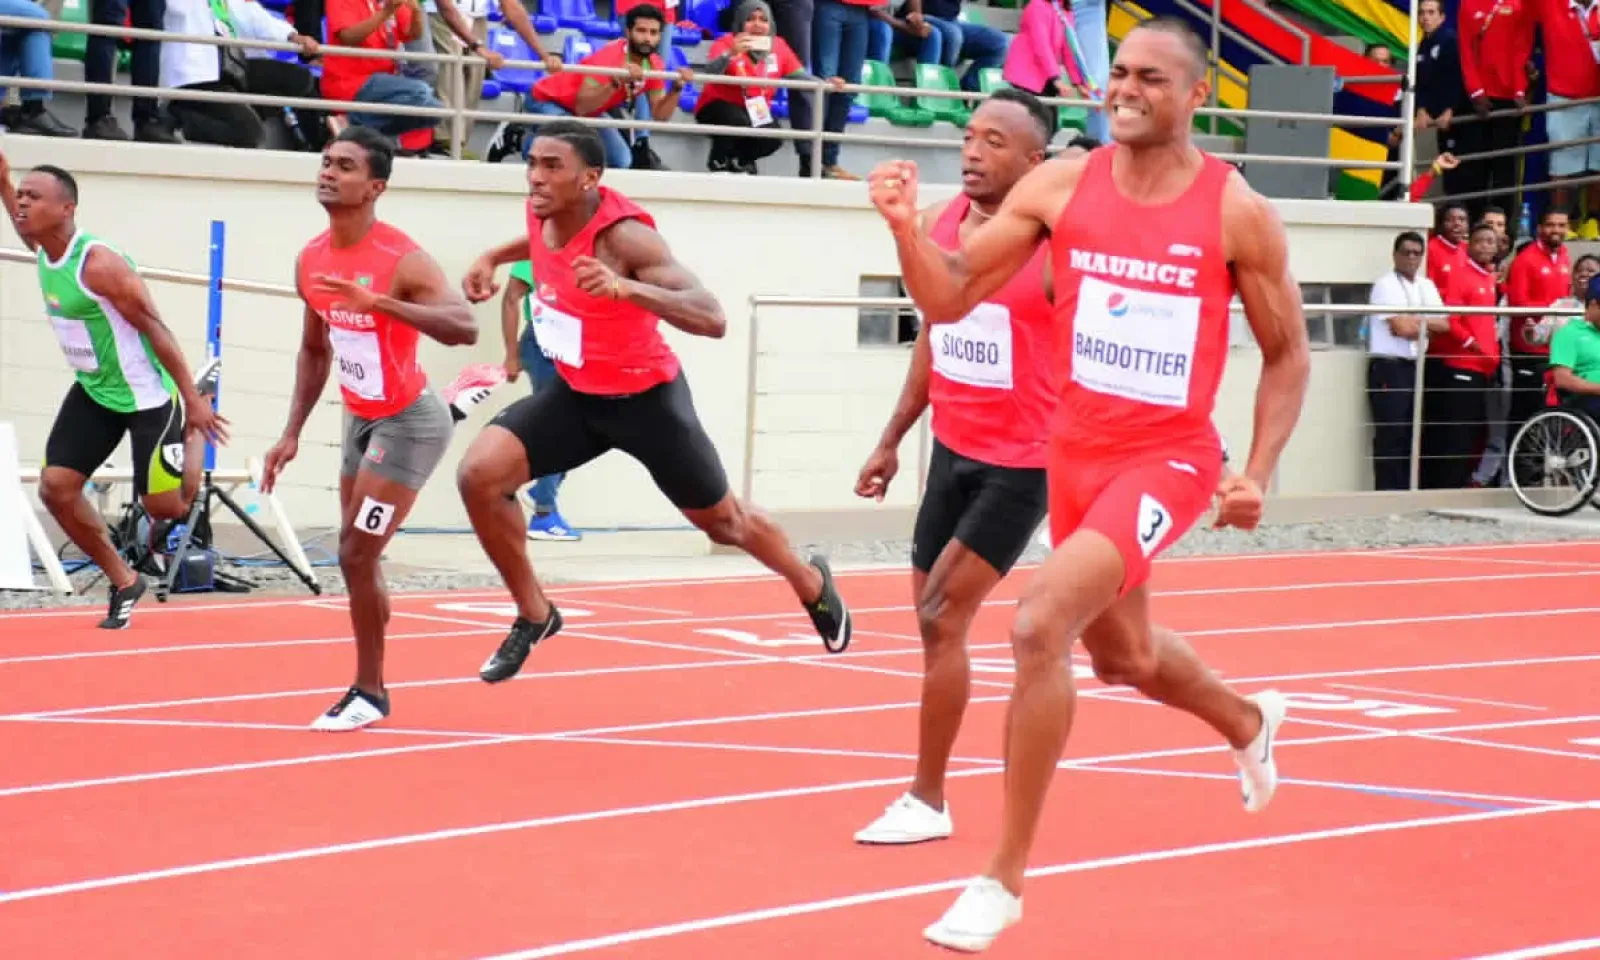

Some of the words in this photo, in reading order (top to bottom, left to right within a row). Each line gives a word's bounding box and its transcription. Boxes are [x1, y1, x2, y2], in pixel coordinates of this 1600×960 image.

[1070, 248, 1197, 288] MAURICE
[942, 331, 999, 365] SICOBO
[1076, 332, 1188, 376] BARDOTTIER
[365, 505, 384, 530] 6
[1141, 508, 1163, 543] 3
